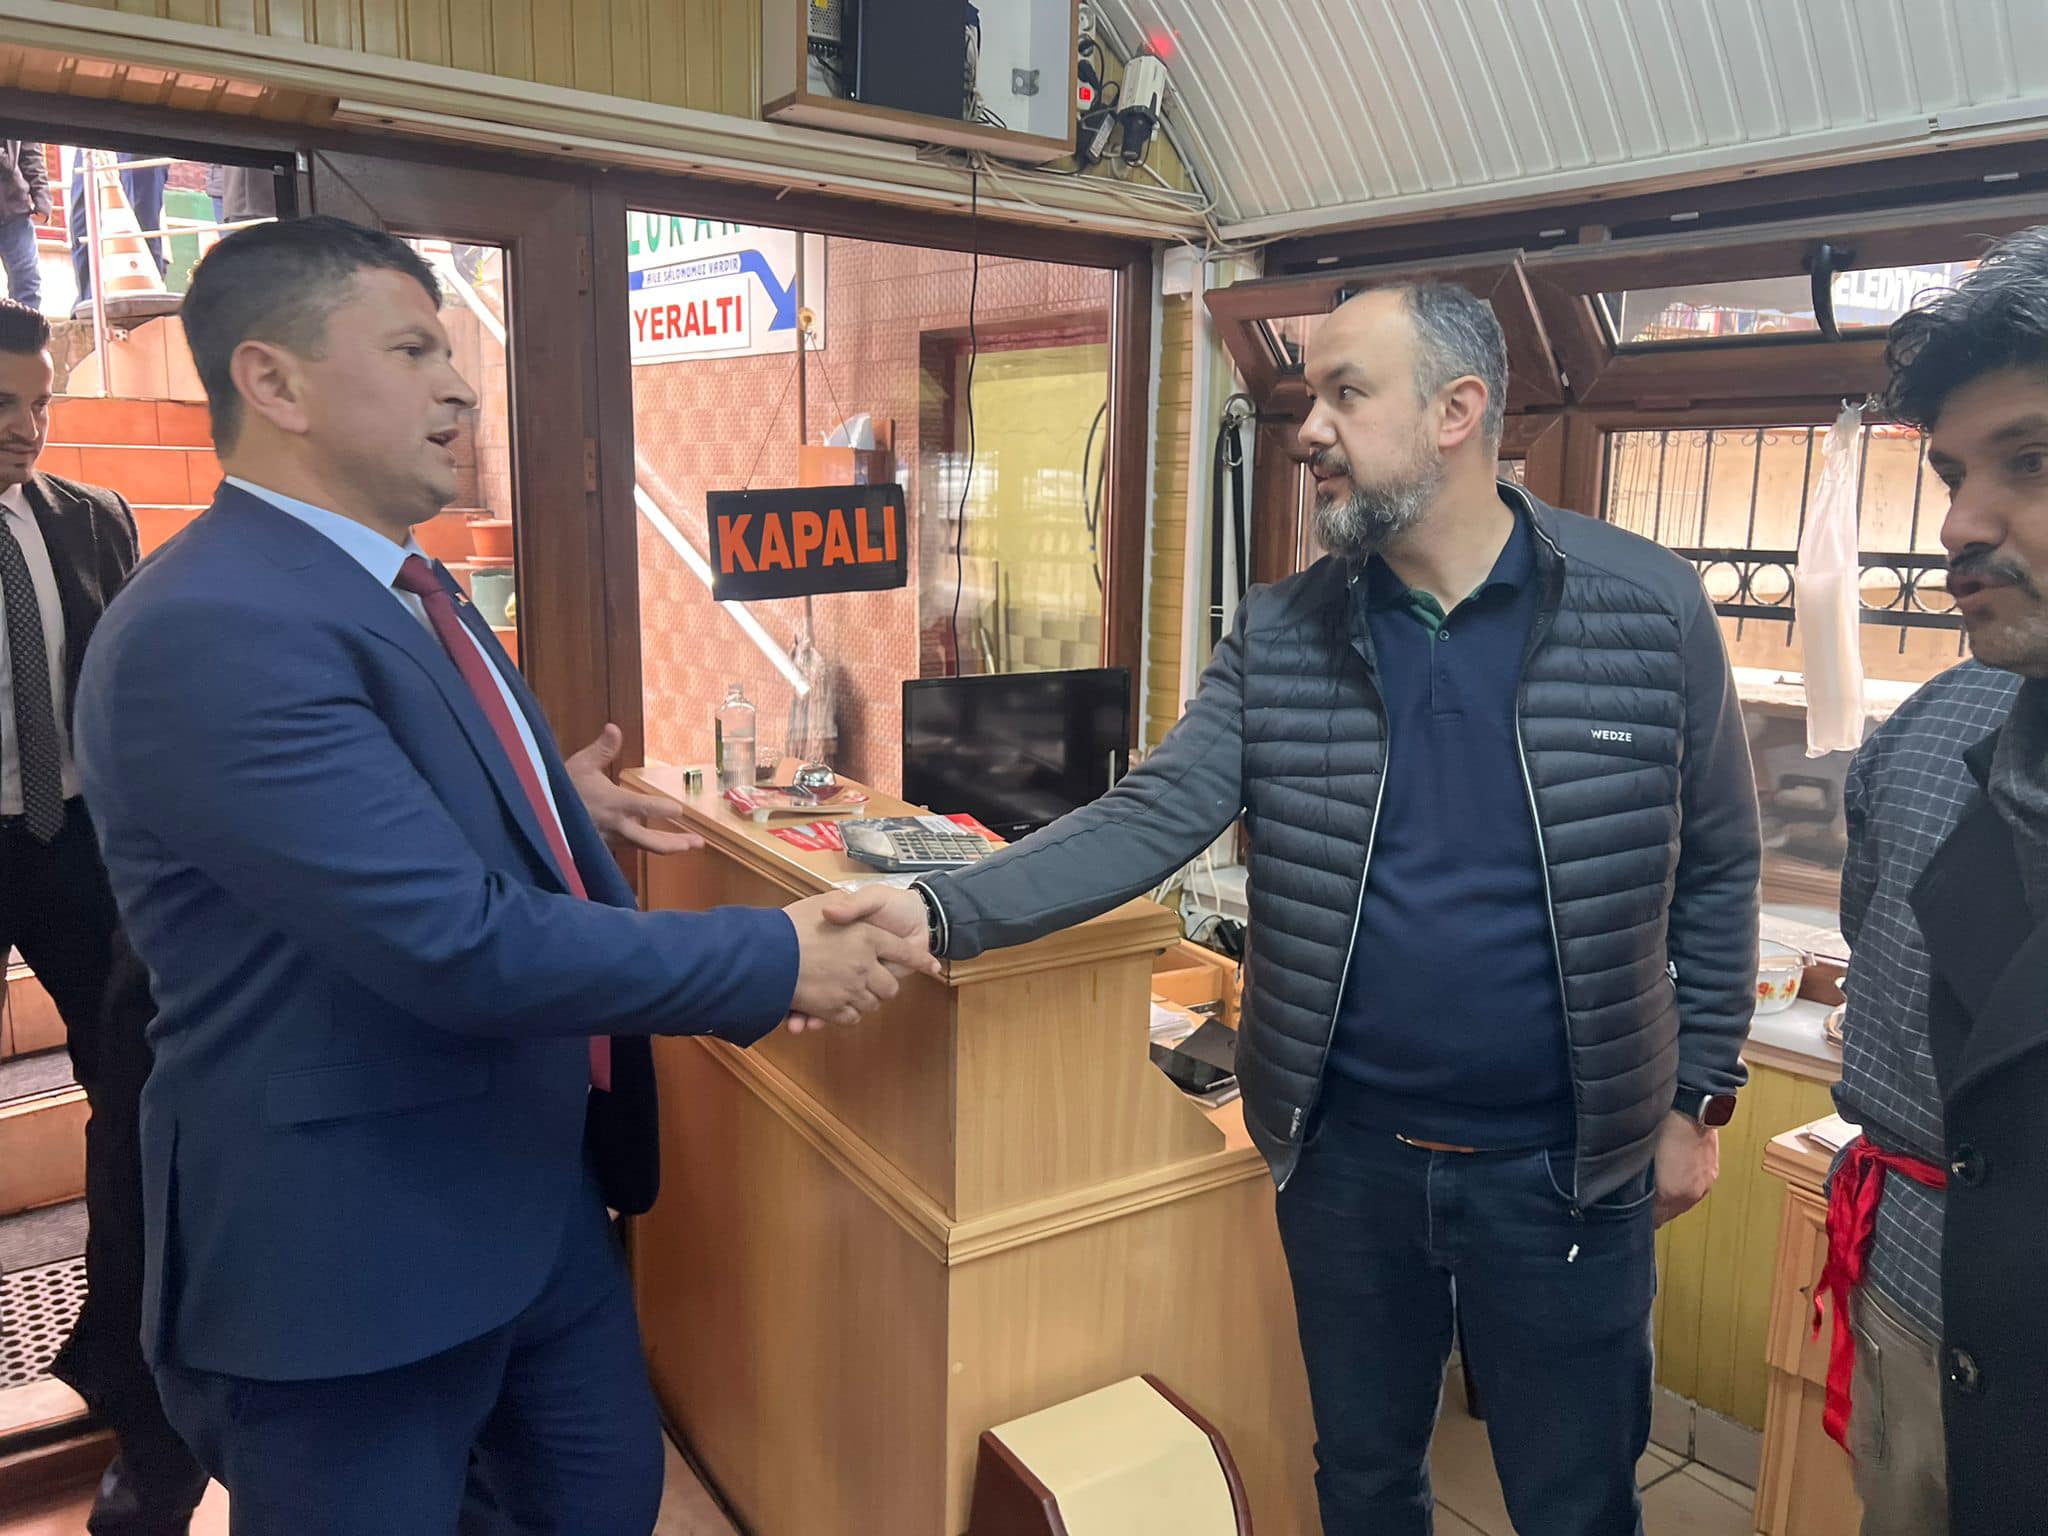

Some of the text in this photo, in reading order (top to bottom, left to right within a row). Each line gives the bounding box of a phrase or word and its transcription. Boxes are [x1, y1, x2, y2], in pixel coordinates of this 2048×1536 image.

[634, 295, 743, 342] YERALTI
[717, 506, 897, 574] KAPALI
[1590, 729, 1632, 742] WEDZE
